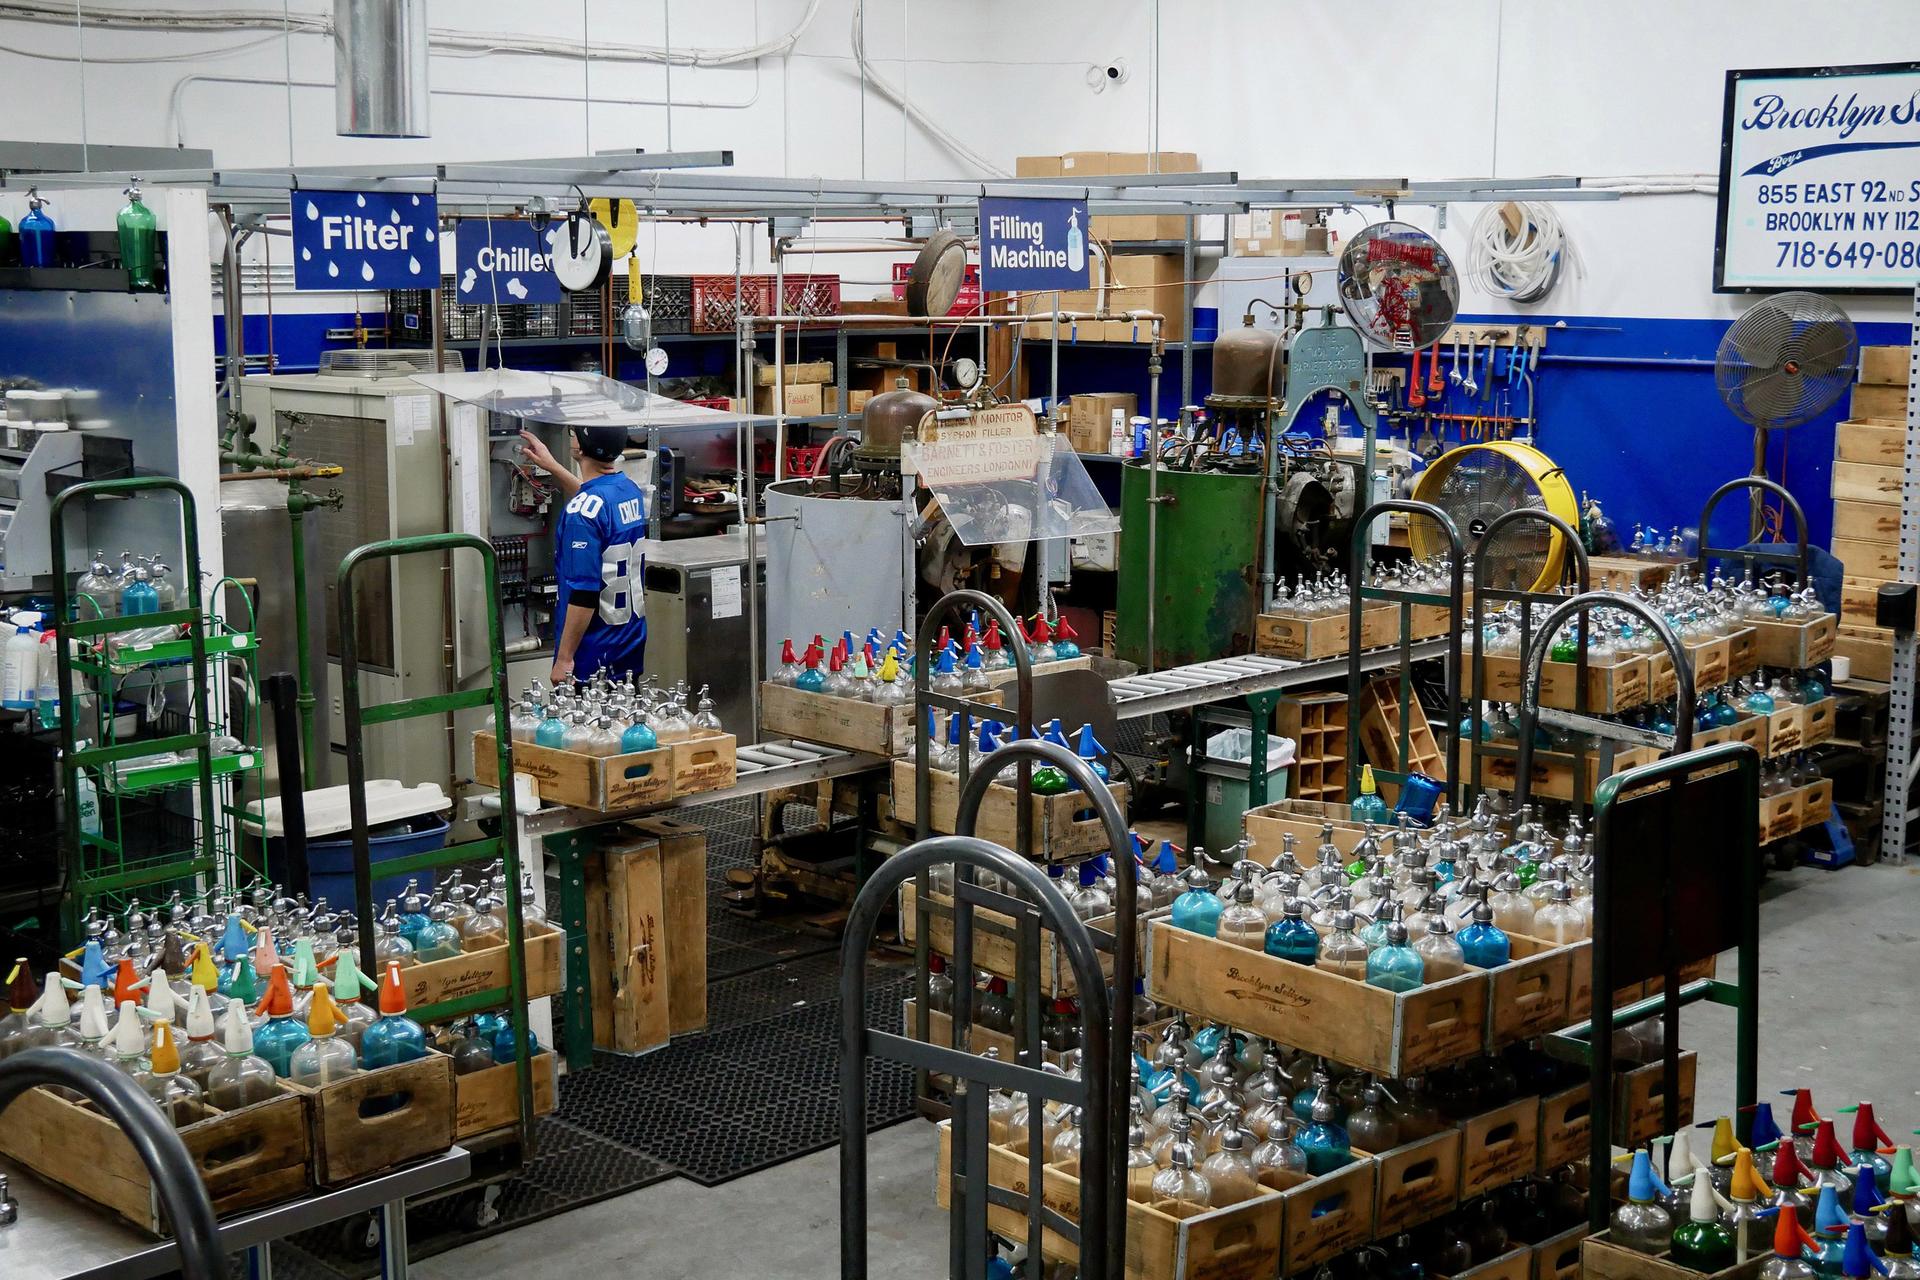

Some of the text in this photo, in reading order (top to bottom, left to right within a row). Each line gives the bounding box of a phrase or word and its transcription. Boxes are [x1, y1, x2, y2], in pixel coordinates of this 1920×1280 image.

[1741, 88, 1920, 139] Brooklyn S
[1767, 151, 1803, 174] Boys
[1758, 184, 1798, 205] 855
[1804, 182, 1856, 204] EAST
[322, 215, 413, 250] Filter
[990, 215, 1043, 245] Filling
[1766, 211, 1856, 232] BROOKLYN
[1863, 211, 1889, 231] NY
[477, 246, 556, 273] Chiller
[991, 244, 1067, 268] Machine
[981, 412, 1023, 425] MONITOR
[941, 428, 1012, 440] SYPHON FILLER
[922, 443, 978, 462] BARNETT
[927, 464, 980, 478] ENGINEERS
[566, 492, 604, 518] 80
[618, 499, 643, 525] CRUZ
[1226, 967, 1271, 992] Brooklyn
